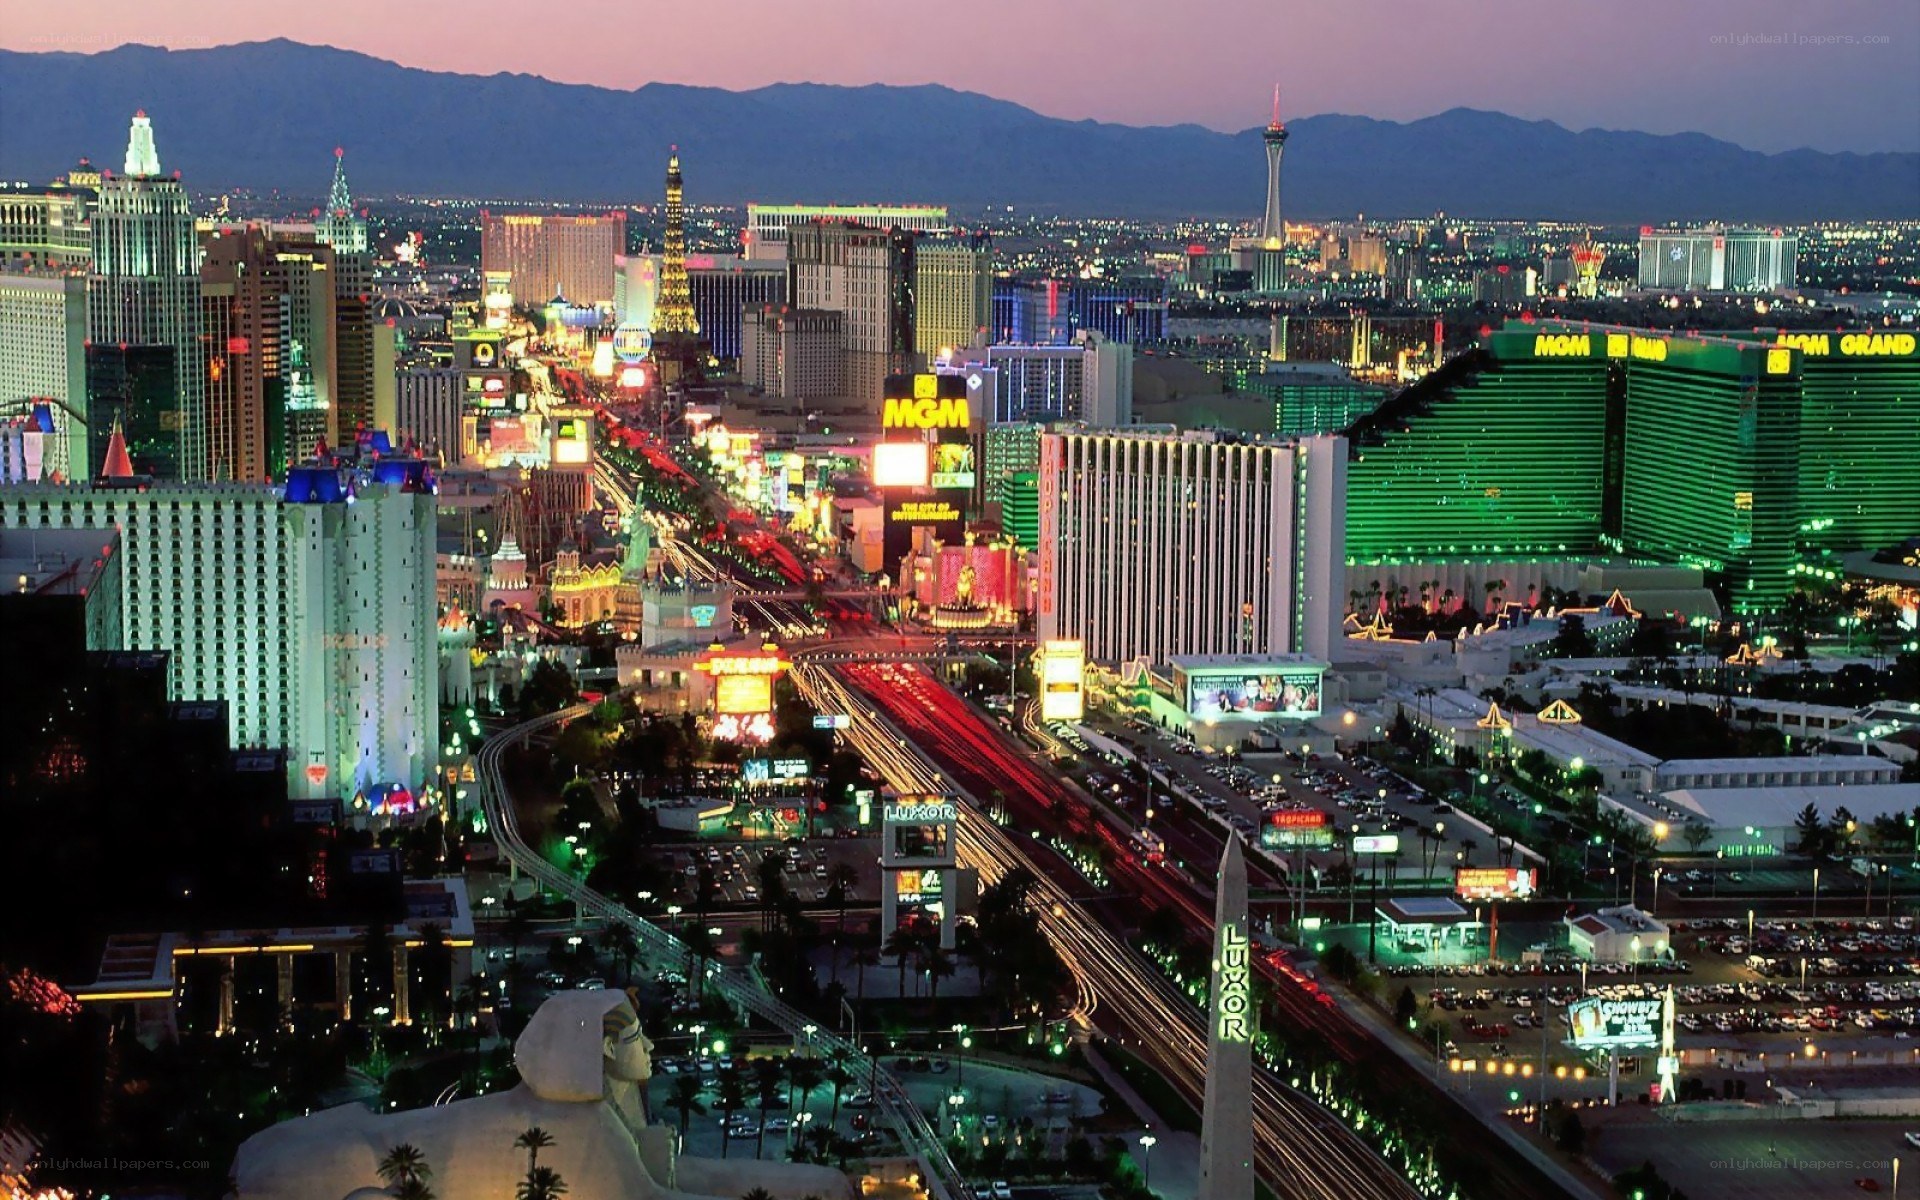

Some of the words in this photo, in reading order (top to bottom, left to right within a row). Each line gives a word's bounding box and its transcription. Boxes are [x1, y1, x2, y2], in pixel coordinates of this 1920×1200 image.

[1534, 334, 1591, 356] MGM
[1840, 333, 1916, 356] GRAND
[882, 398, 970, 429] MGM
[884, 804, 957, 821] LUXOR
[1219, 924, 1250, 1042] LUXOR
